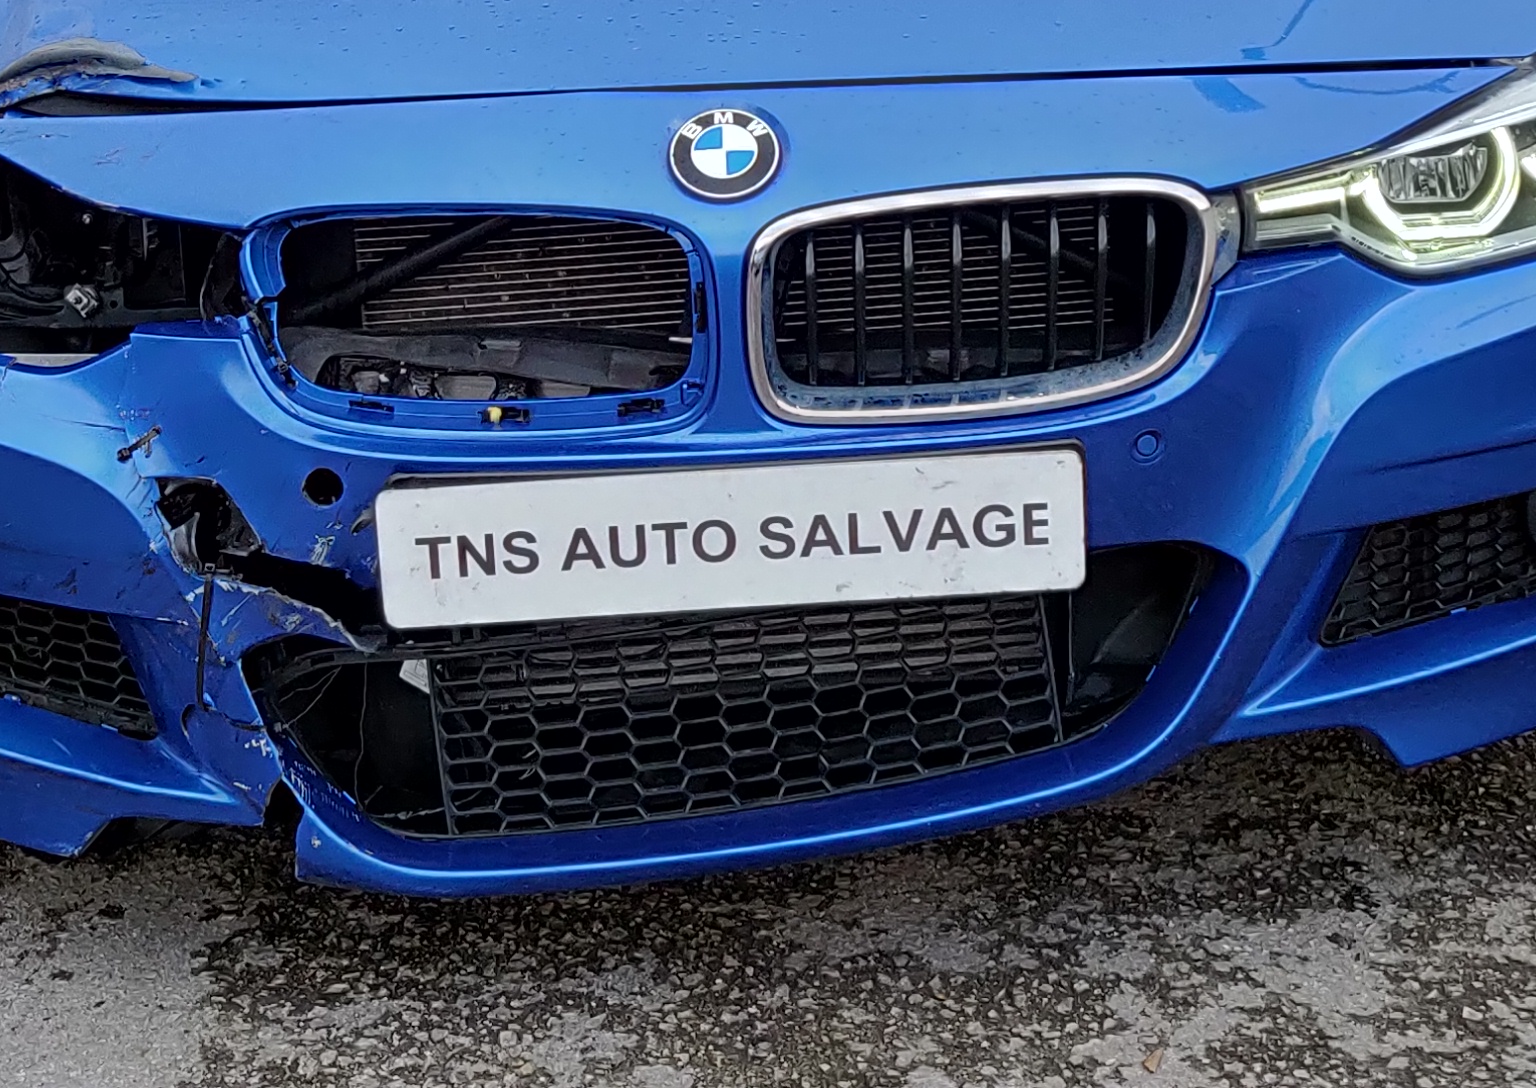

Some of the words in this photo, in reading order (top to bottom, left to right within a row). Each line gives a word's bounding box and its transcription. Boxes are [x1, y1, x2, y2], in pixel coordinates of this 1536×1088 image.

[680, 111, 769, 140] BMW
[414, 530, 540, 580] TNS
[561, 519, 737, 571] AUTO
[759, 502, 1050, 560] SALVAGE
